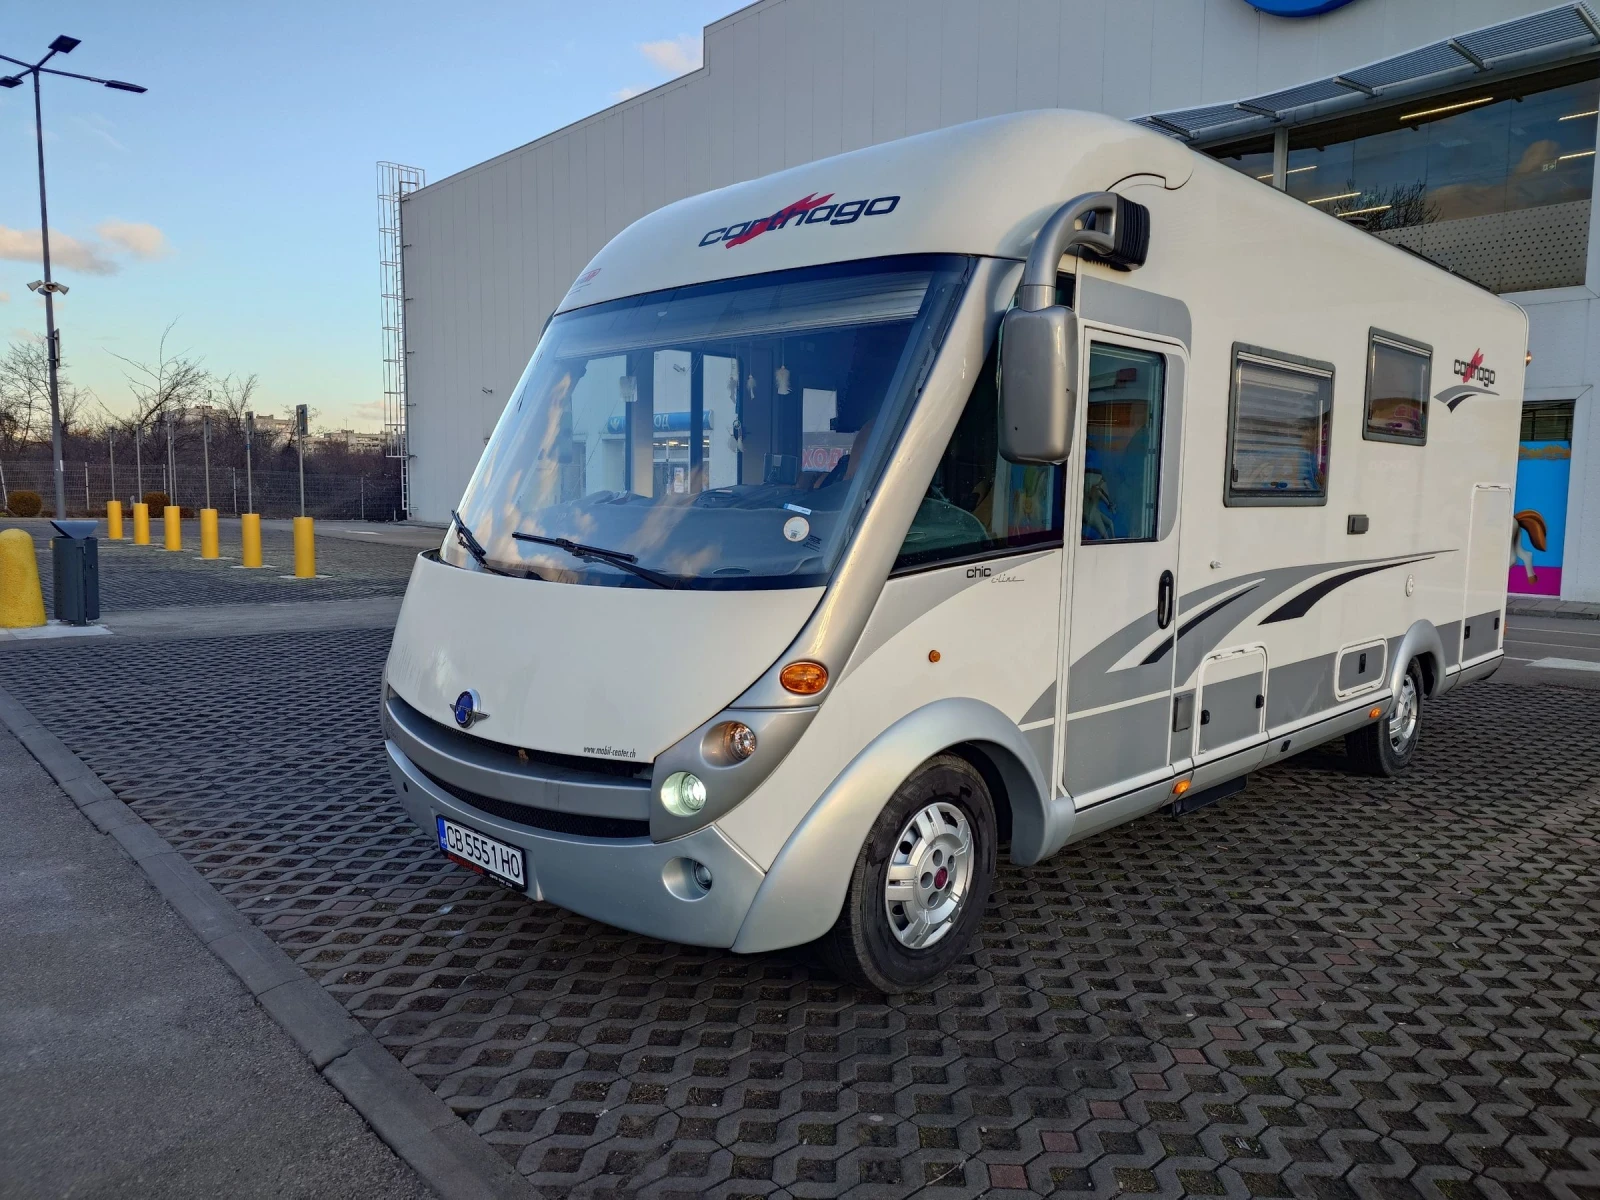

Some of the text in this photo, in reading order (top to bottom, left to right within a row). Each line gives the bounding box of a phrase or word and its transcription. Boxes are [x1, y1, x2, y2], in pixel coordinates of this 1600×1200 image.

[698, 195, 901, 247] carthago
[966, 566, 992, 579] chic
[583, 745, 636, 759] www.mobil-center.ch
